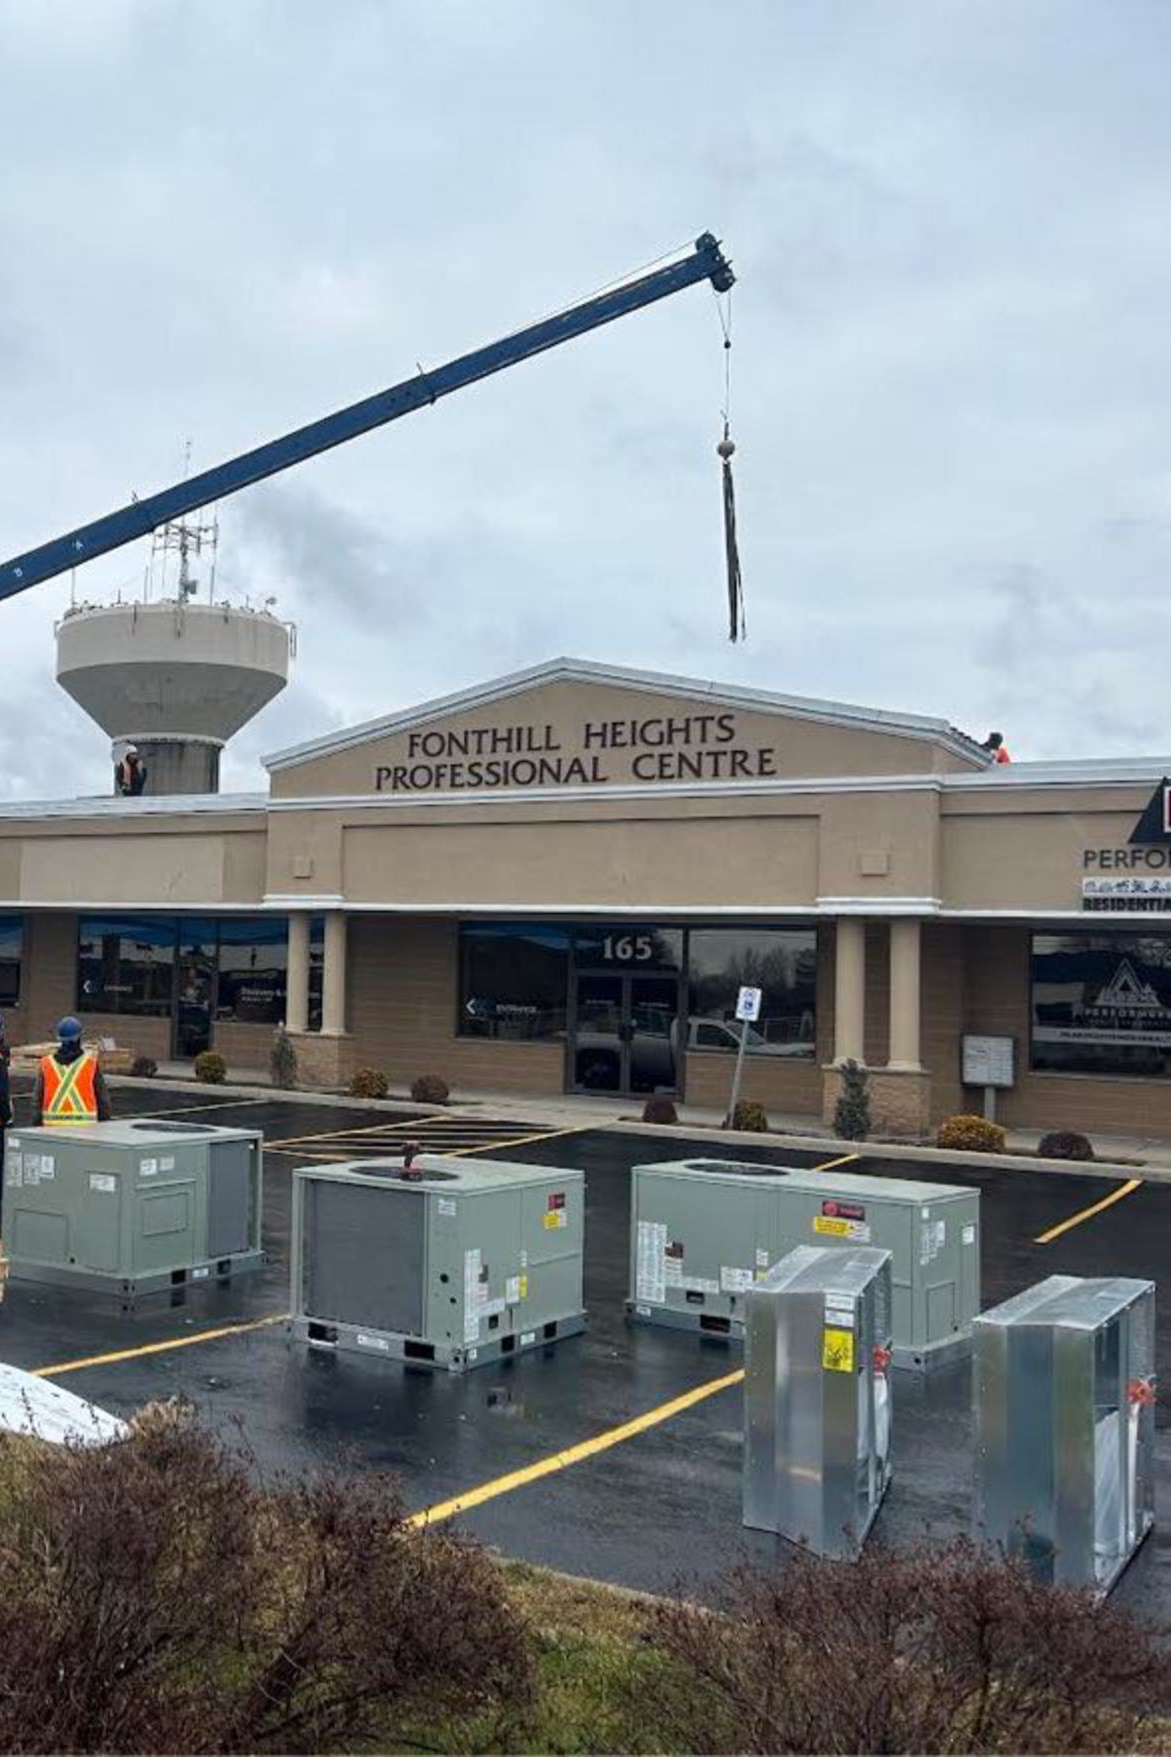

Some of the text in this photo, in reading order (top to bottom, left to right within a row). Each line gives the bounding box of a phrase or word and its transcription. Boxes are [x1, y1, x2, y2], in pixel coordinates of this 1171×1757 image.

[407, 714, 736, 758] FONTHILL HEIGHTS
[375, 748, 778, 790] PROFESSIONAL CENTRE
[1083, 848, 1171, 869] PERFO
[603, 936, 652, 960] 165
